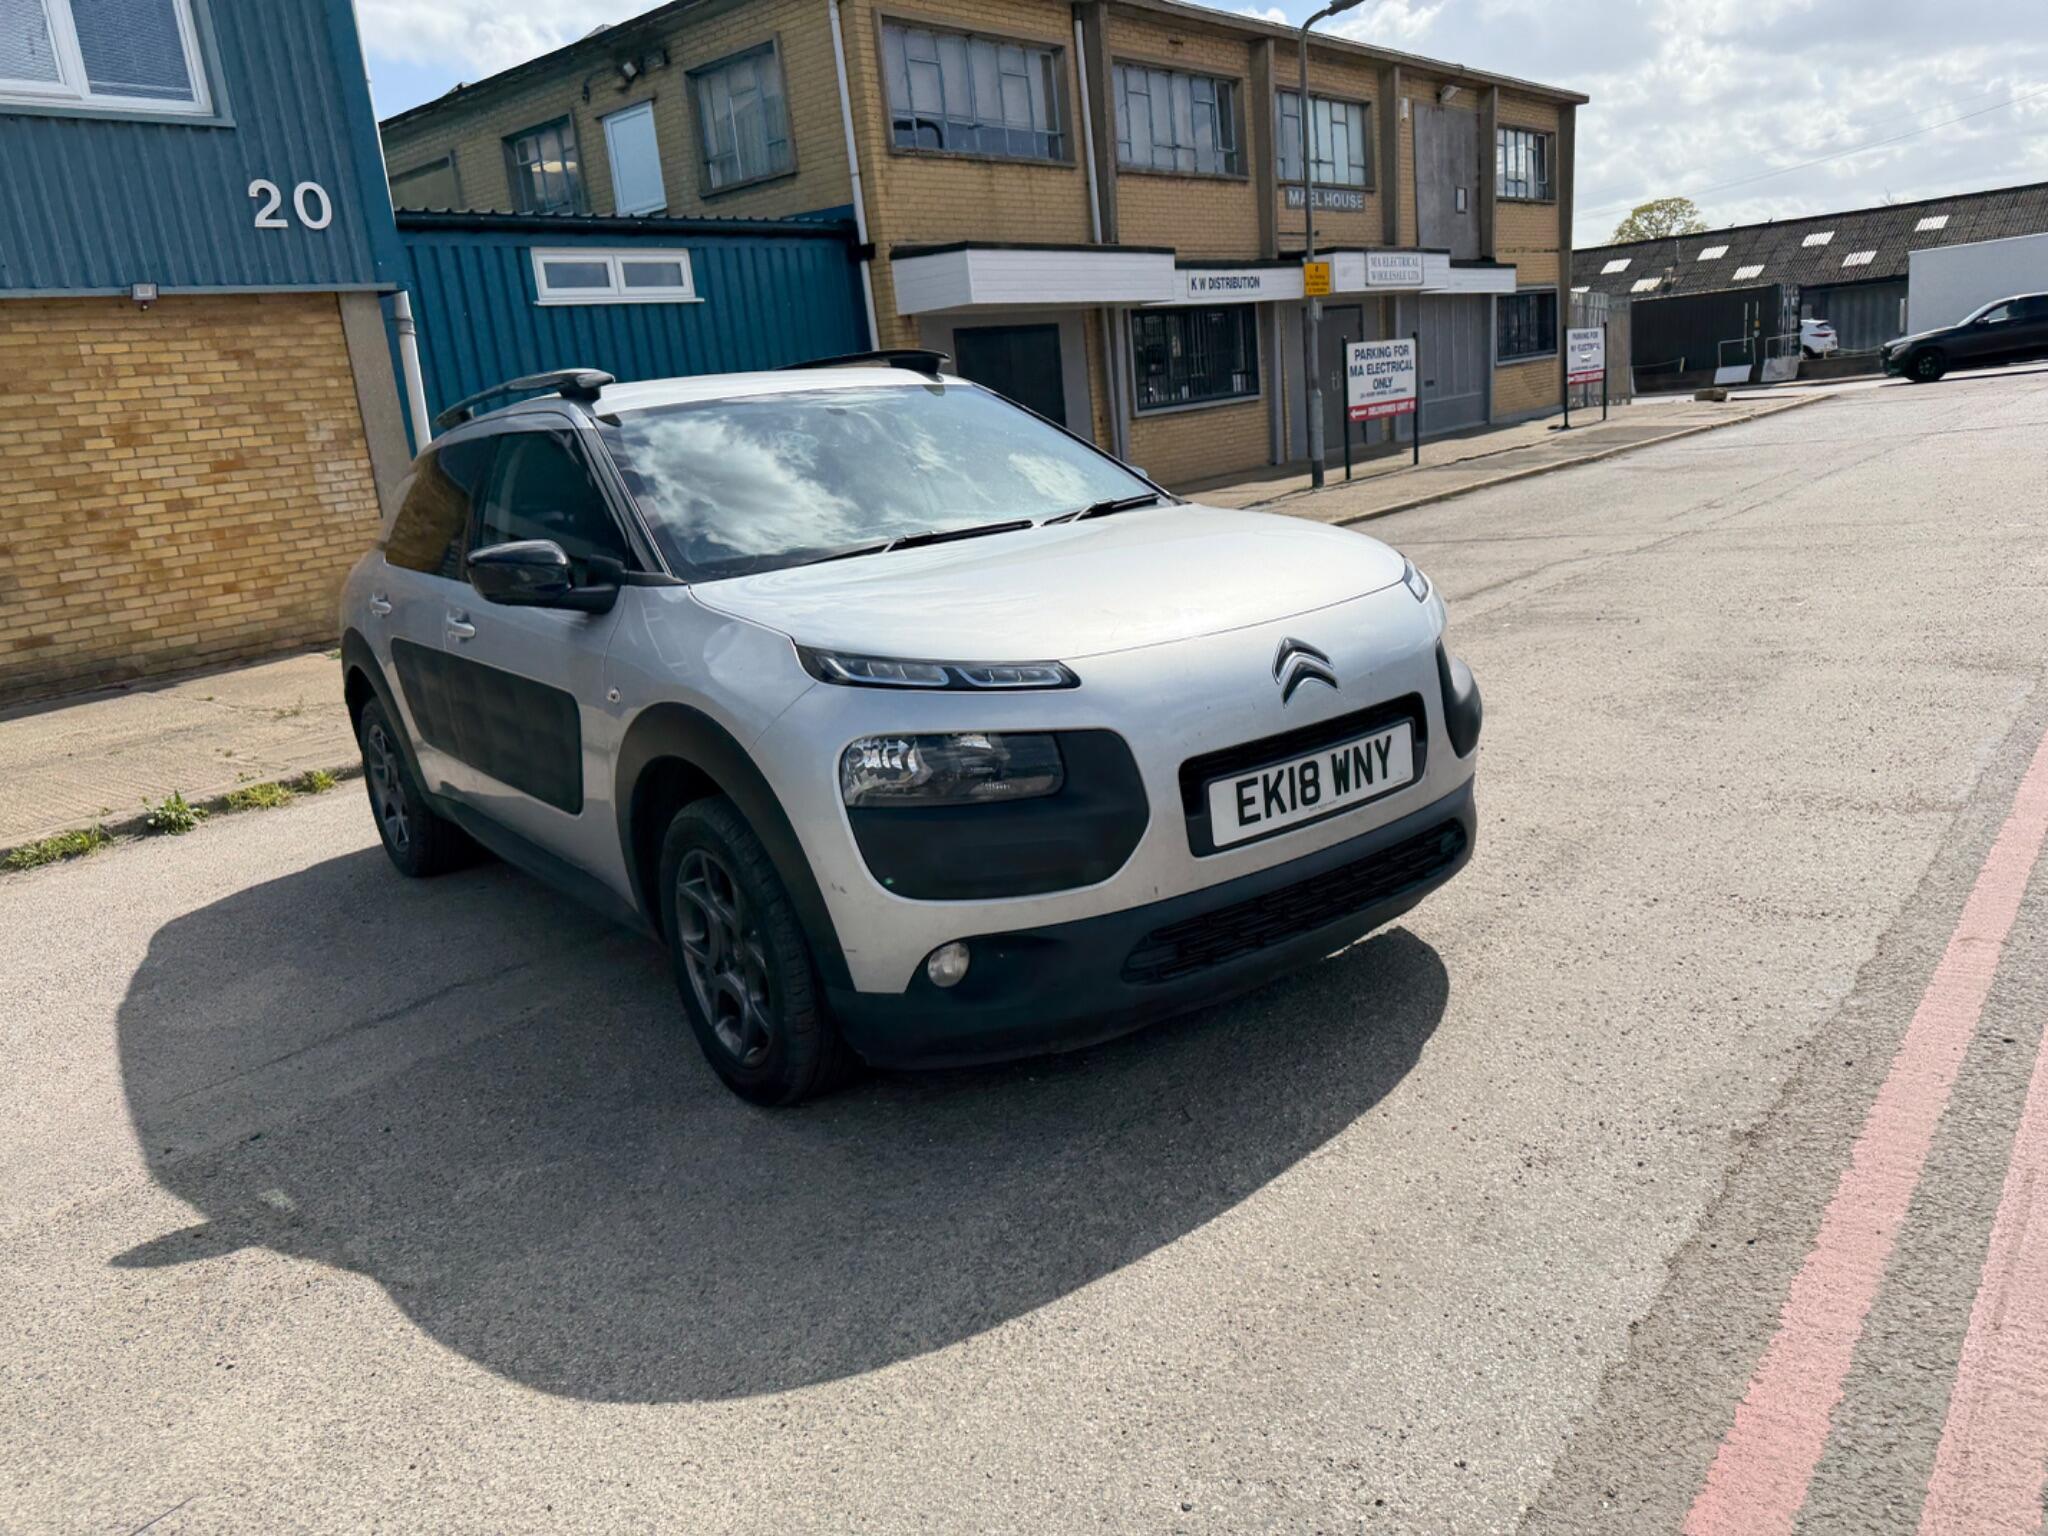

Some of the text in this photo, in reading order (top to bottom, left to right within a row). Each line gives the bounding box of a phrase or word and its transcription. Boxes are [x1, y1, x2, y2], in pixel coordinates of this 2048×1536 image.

[248, 179, 333, 230] 20
[1324, 192, 1363, 208] HOUSE
[1382, 256, 1418, 267] ELECTRICAL
[1191, 275, 1260, 291] K W DISTRIBUTION
[1370, 270, 1407, 280] WHOLESALE
[1354, 344, 1408, 360] PARKING FOR
[1349, 360, 1413, 378] MA ELECTRICAL
[1372, 376, 1393, 390] ONLY
[1236, 735, 1392, 826] EK18 WNY
